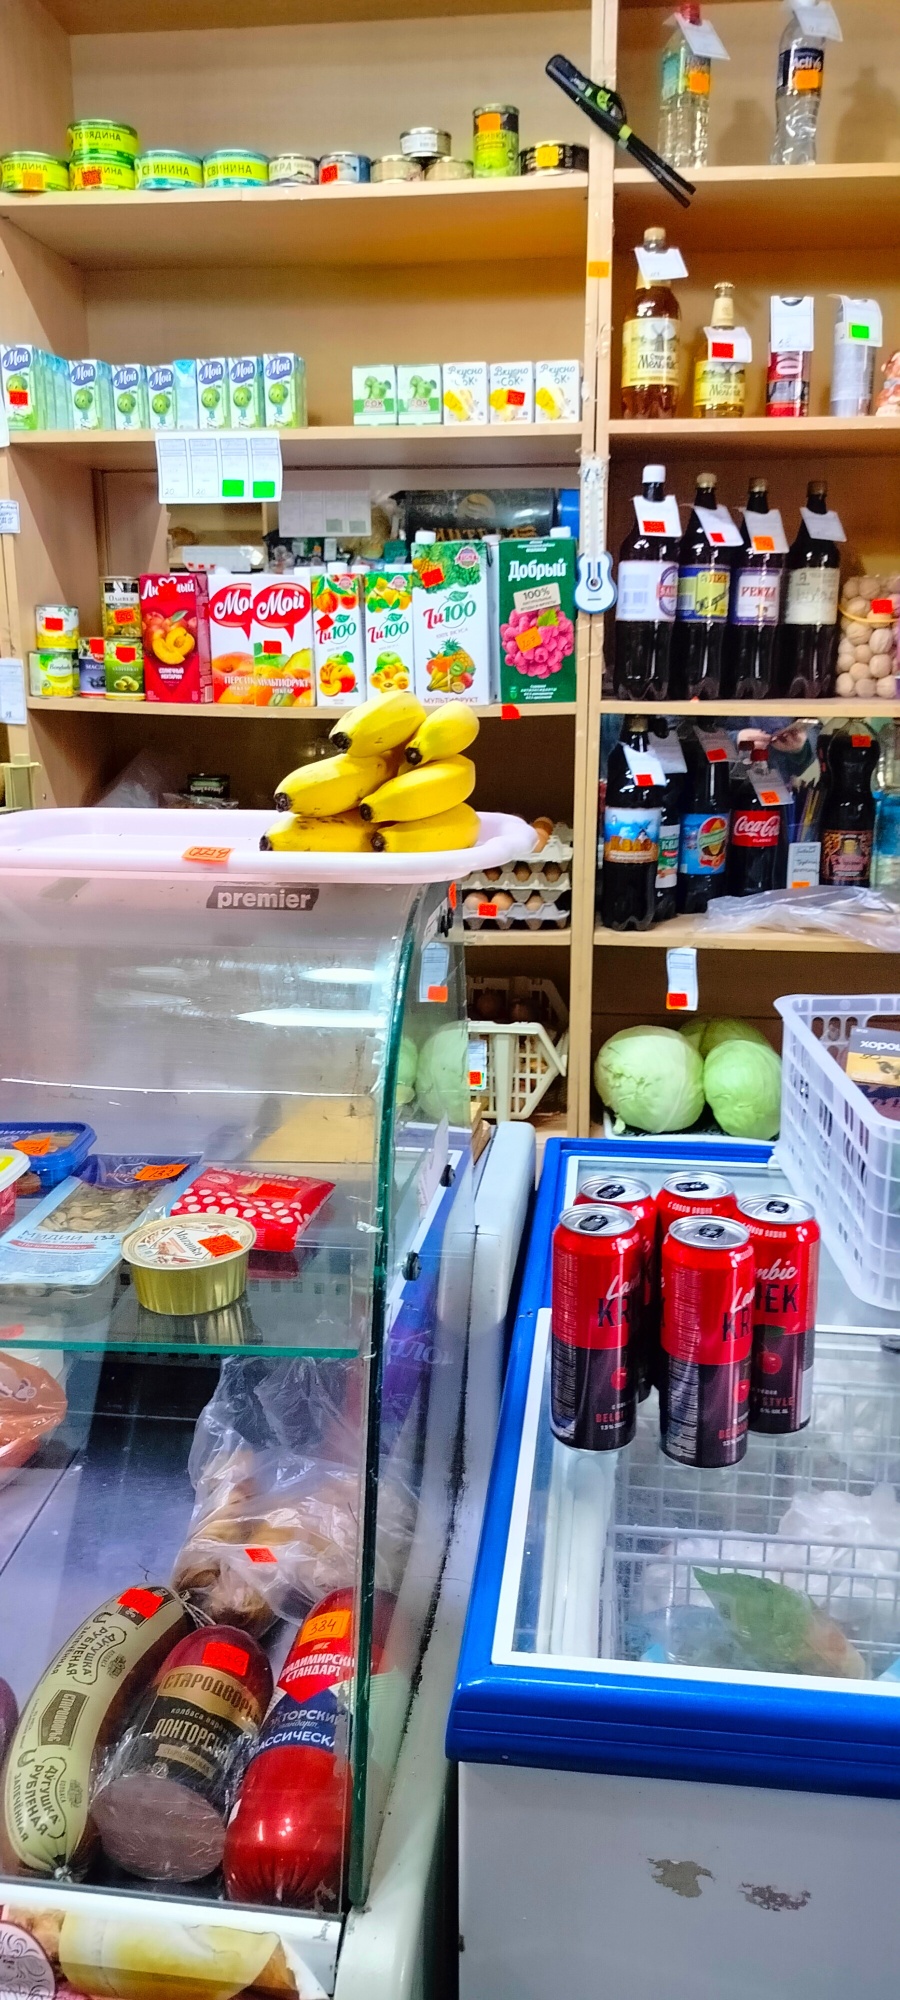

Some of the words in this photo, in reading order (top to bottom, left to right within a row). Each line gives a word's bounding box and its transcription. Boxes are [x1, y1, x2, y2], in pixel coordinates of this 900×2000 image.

[74, 130, 122, 142] ГОВЯДИНА
[3, 347, 29, 366] Мой
[71, 362, 94, 381] Мой
[114, 368, 138, 386] Мой
[149, 370, 173, 387] Мой
[199, 364, 223, 383] Мой
[231, 362, 255, 382] Мой
[266, 359, 291, 380] Мой
[508, 557, 568, 582] Добрый
[522, 586, 551, 601] 100%
[256, 588, 305, 621] Мой
[217, 889, 311, 909] premier
[309, 1617, 337, 1636] 384
[66, 1626, 109, 1678] РУБЛЕНАЯ
[82, 1632, 117, 1678] ДУГУШКА
[286, 1664, 341, 1683] СТАНДАРТ
[23, 1763, 50, 1837] РУБЛЕНАЯ
[36, 1764, 60, 1826] ДУГУШКА
[12, 1771, 29, 1844] ЗАПЕЧЁННАЯ
